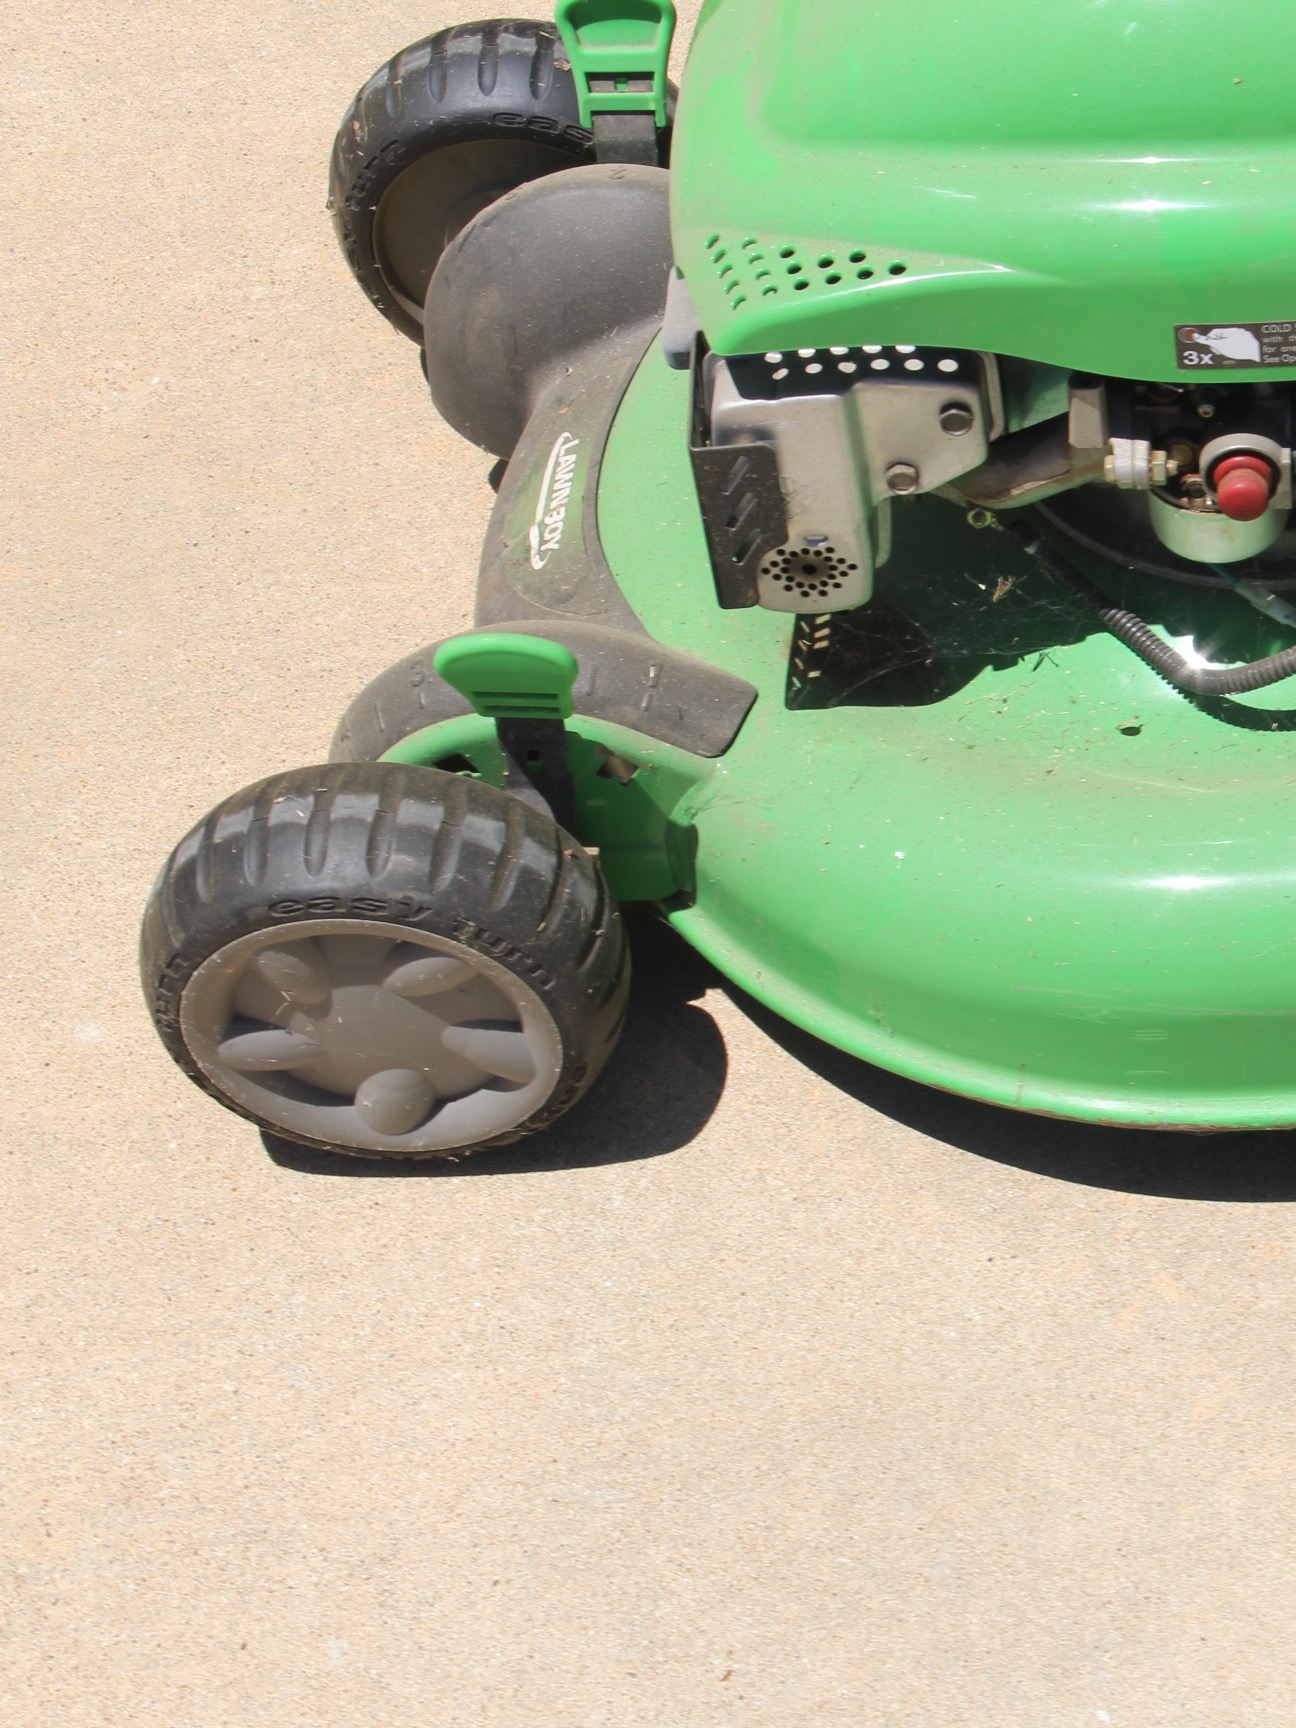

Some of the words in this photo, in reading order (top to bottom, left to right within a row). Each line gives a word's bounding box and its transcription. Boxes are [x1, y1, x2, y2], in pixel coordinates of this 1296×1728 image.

[1261, 324, 1292, 334] COLD
[1262, 336, 1284, 344] with
[1262, 345, 1277, 354] for
[1181, 350, 1215, 366] 3x
[1263, 355, 1280, 364] See
[268, 895, 434, 922] easy
[451, 915, 557, 991] turn
